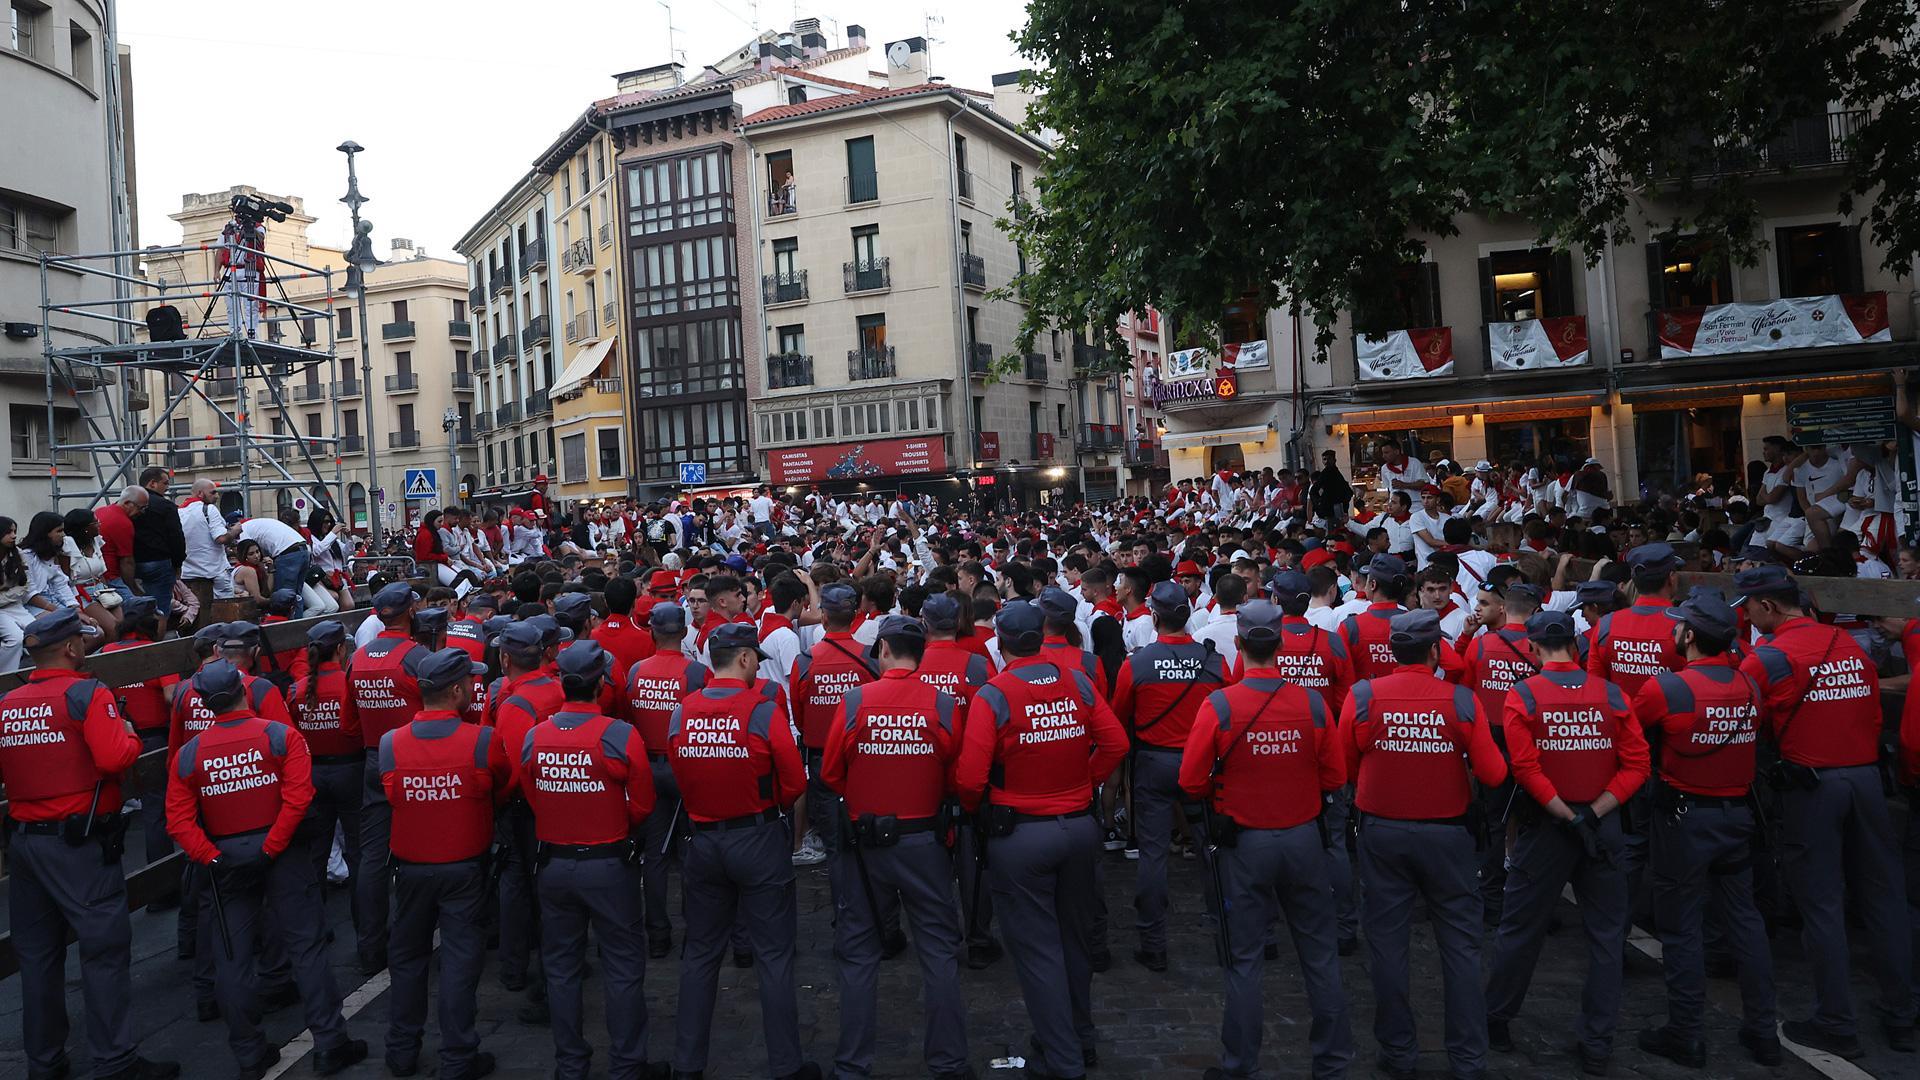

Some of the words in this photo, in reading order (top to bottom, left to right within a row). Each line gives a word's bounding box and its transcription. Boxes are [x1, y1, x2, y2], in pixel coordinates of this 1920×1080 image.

[895, 459, 929, 467] SWEATSHIRTS
[1613, 640, 1662, 653] POLICÍA
[1277, 653, 1324, 666] POLICÍA
[1617, 652, 1660, 664] FORAL
[1281, 666, 1322, 676] FORAL
[1809, 656, 1864, 677] POLICÍA
[354, 676, 395, 689] POLICÍA
[637, 678, 680, 690] POLICÍA
[814, 670, 860, 684] POLICÍA
[920, 671, 959, 684] OLICÍA
[1816, 672, 1864, 688] FORAL
[358, 689, 395, 699] FORAL
[639, 689, 677, 700] FORAL
[2, 703, 53, 720] POLICÍA
[632, 699, 681, 711] FORUZAINGO
[1025, 697, 1078, 717] POLICÍA
[302, 711, 340, 721] FORAL
[867, 712, 928, 728] POLICÍA
[1031, 713, 1077, 730] FORAL
[1382, 709, 1446, 726] POLICÍA
[1542, 707, 1604, 724] POLICÍA
[3, 719, 50, 734] FORAL
[685, 715, 741, 731] POLICÍA
[688, 731, 736, 744] FORAL
[871, 729, 923, 741] FORAL
[1019, 725, 1086, 745] FORUZAINGOA
[1387, 726, 1443, 739] FORAL
[1548, 724, 1602, 737] FORAL
[858, 742, 935, 755] FORUZAINGOA
[1252, 742, 1298, 756] FORAL
[1374, 739, 1455, 753] FORUZAINGOA
[1536, 738, 1613, 751] FORUZAINGOA
[203, 748, 264, 771] POLICÍA
[537, 750, 593, 766] POLICÍA
[678, 746, 750, 759] FORUZAINGOA
[209, 763, 263, 783] FORAL
[541, 766, 591, 780] FORAL
[200, 772, 279, 797] FORUZAINGOA
[403, 772, 463, 789] POLICÍA
[535, 778, 606, 793] FORUZAINGOA
[405, 787, 462, 801] FORAL
